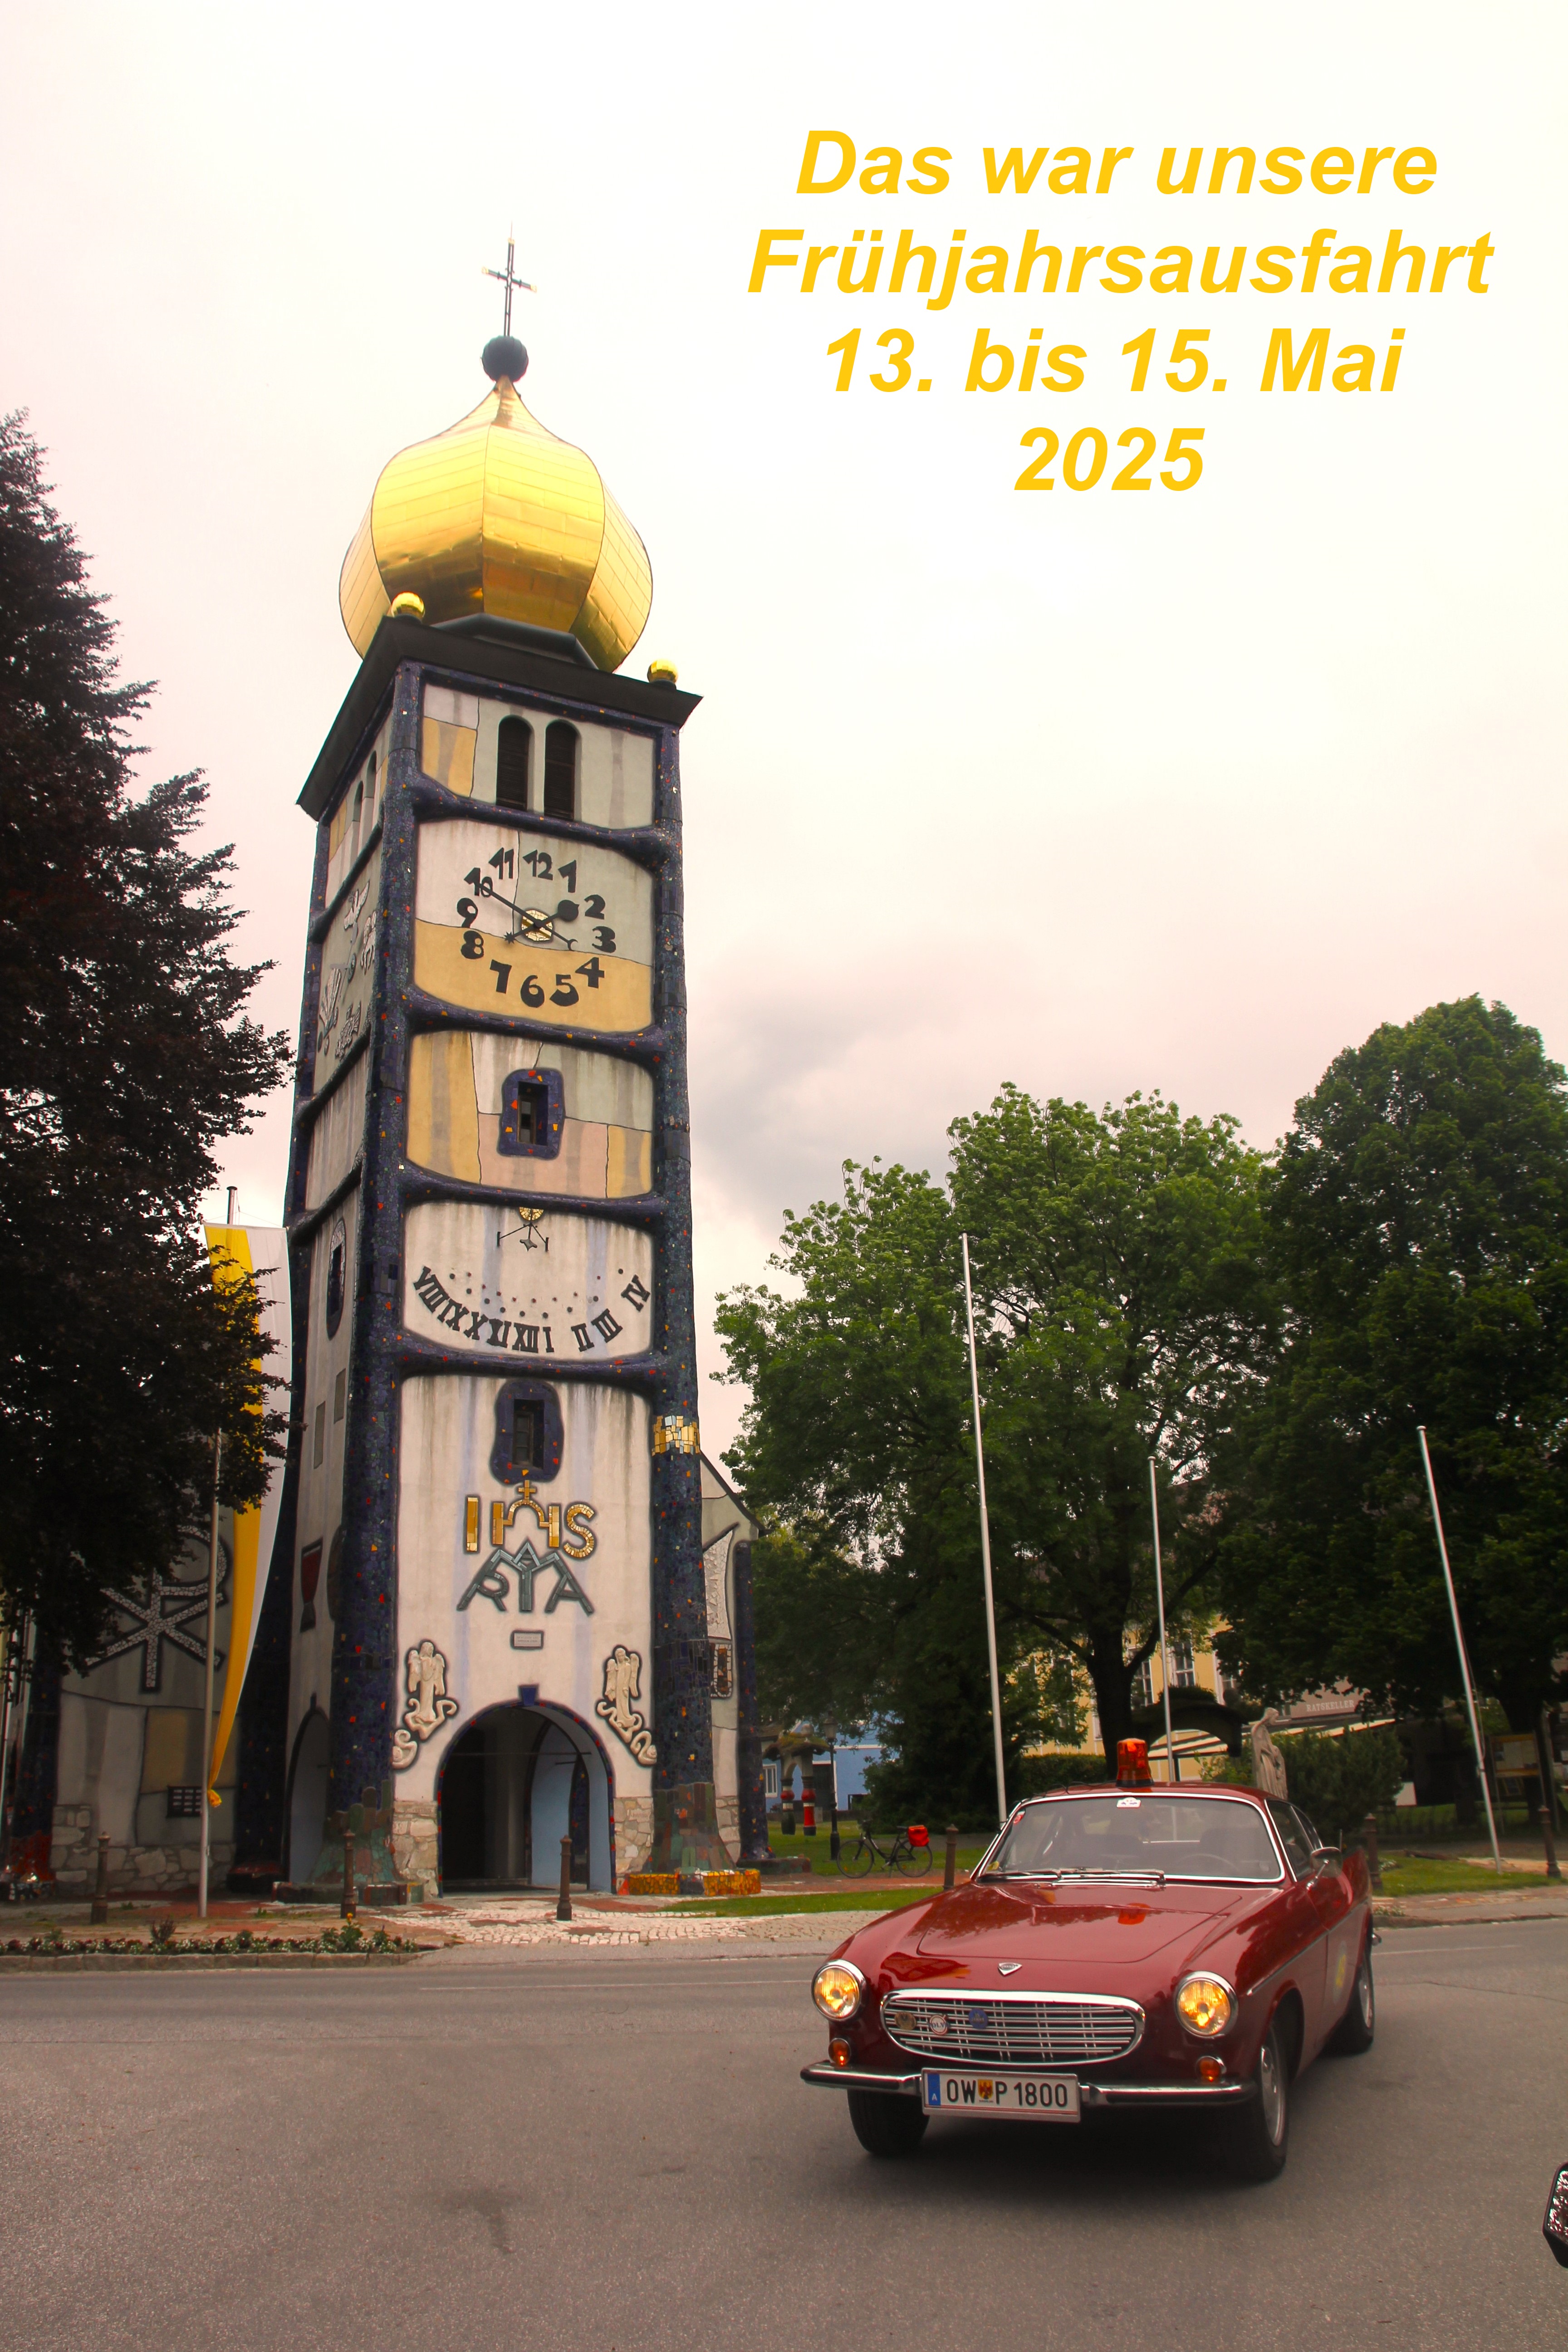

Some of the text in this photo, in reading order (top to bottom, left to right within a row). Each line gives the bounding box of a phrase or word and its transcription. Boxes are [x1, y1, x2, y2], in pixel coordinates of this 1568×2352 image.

[489, 848, 514, 879] 11
[523, 850, 553, 881] 12
[558, 860, 577, 893] 1
[464, 867, 493, 897] 10
[457, 897, 478, 928] 9
[584, 894, 606, 919] 2
[461, 931, 484, 960] 8
[592, 926, 616, 953] 3
[490, 960, 512, 994] 7
[575, 957, 604, 989] 4
[520, 975, 544, 1008] 6
[550, 974, 579, 1007] 5
[413, 1266, 450, 1313] VIII
[621, 1274, 651, 1312] IV
[437, 1298, 470, 1332] IX
[463, 1311, 489, 1340] X
[591, 1308, 623, 1343] III
[512, 1323, 539, 1353] XII
[543, 1327, 554, 1353] I
[571, 1323, 594, 1352] II
[466, 1497, 594, 1558] IHS
[1306, 1700, 1354, 1712] RATSKELLER
[931, 2093, 937, 2102] A
[947, 2079, 1068, 2107] OW P 1800
